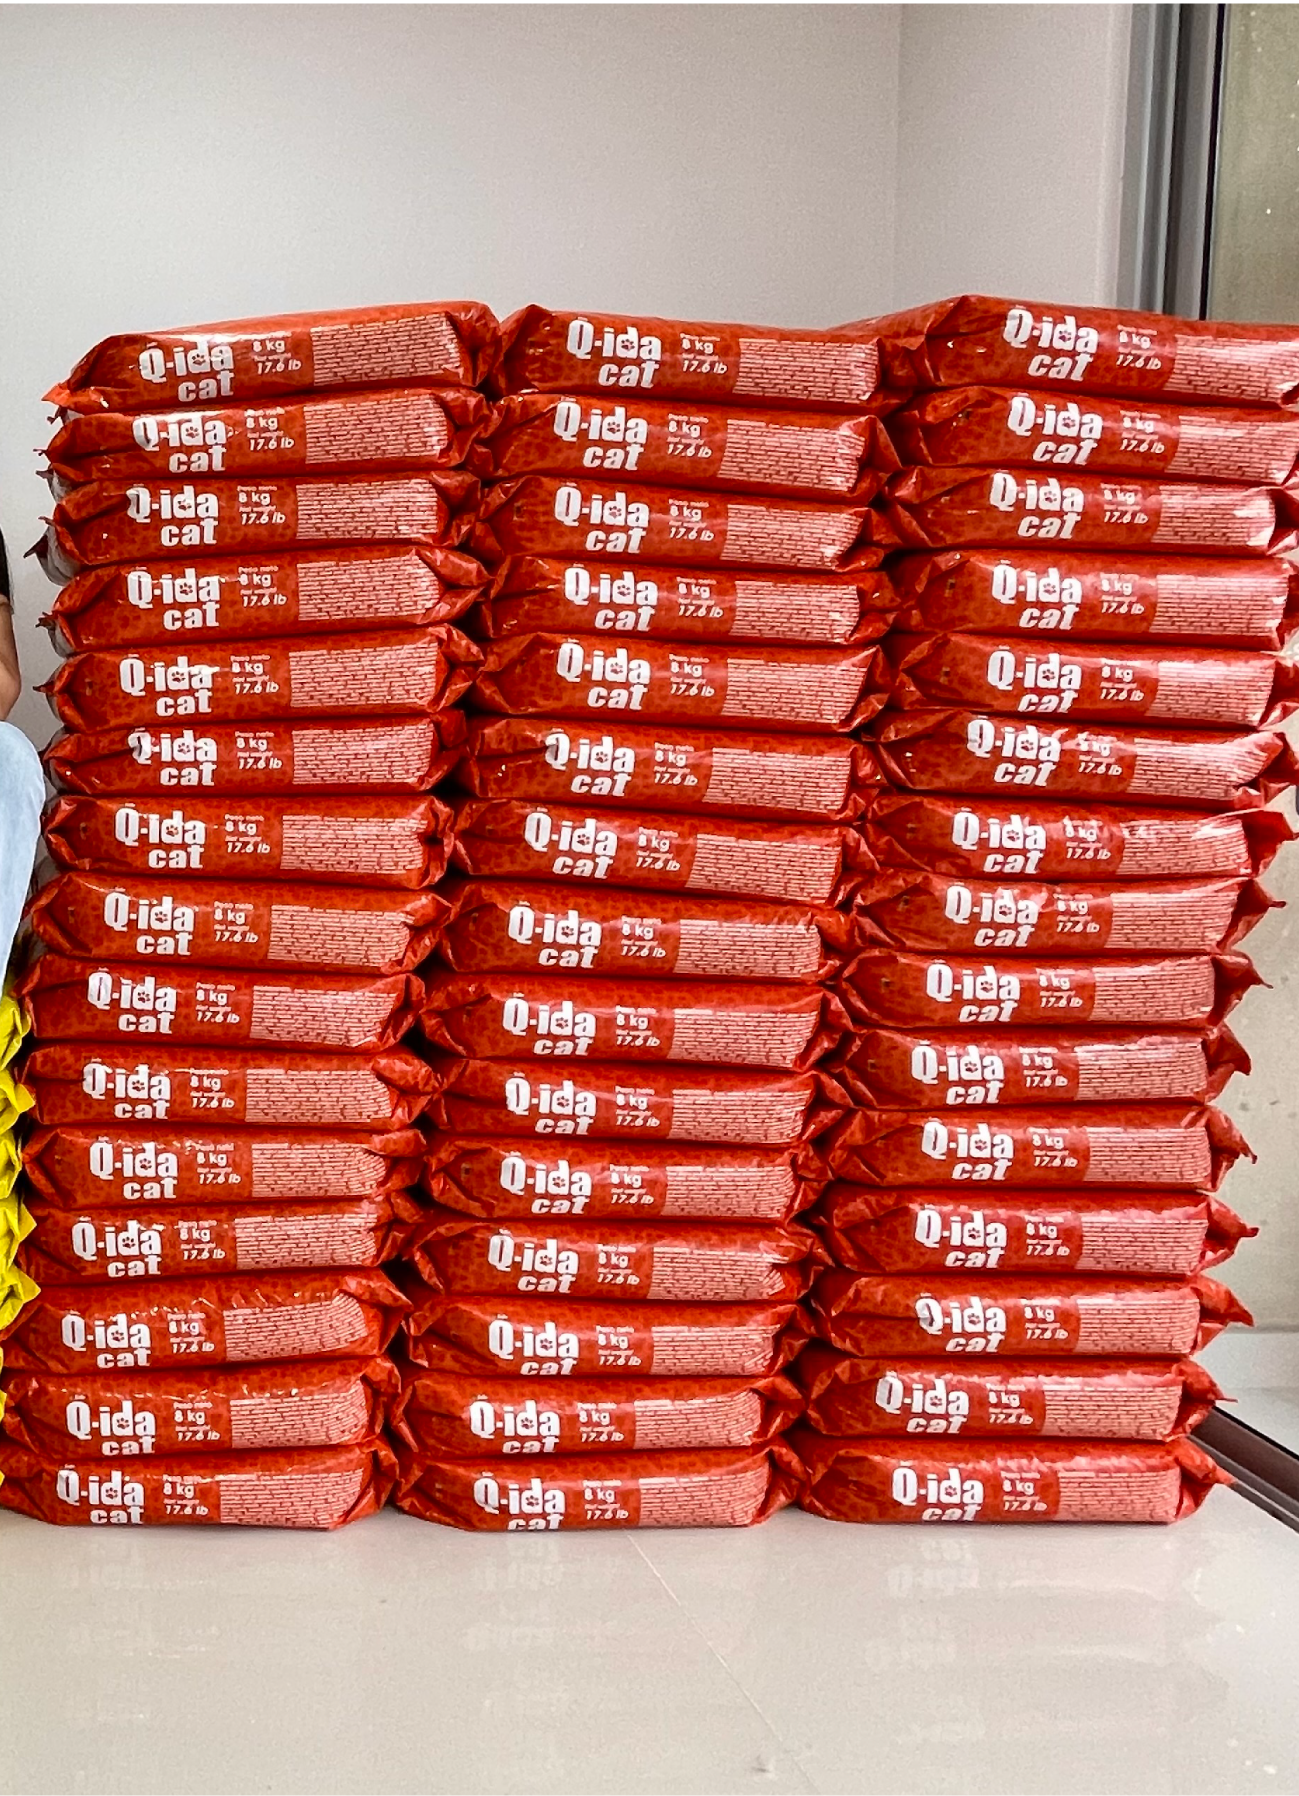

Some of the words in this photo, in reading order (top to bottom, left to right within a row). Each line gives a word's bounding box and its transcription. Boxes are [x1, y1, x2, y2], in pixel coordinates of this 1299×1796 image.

[1003, 308, 1099, 353] Q-ida
[566, 319, 662, 361] Q-ida
[682, 339, 690, 350] 8
[693, 340, 713, 354] kg
[599, 361, 659, 388] cat
[682, 360, 709, 373] 17.6
[713, 361, 727, 374] lb
[1028, 353, 1093, 380] cat
[126, 486, 219, 524] Q-ida
[239, 492, 247, 503] 8
[251, 491, 270, 506] kg
[241, 511, 270, 524] 17.6
[273, 511, 285, 523] lb
[161, 518, 218, 547] cat
[127, 568, 220, 605] Q-ida
[164, 601, 219, 630] cat
[557, 643, 650, 684] Q-ida
[671, 663, 679, 673] 8
[682, 663, 702, 677] kg
[987, 651, 1081, 690] Q-ida
[1102, 665, 1110, 676] 8
[1113, 665, 1133, 681] kg
[588, 684, 648, 710] cat
[670, 683, 698, 696] 17.6
[701, 685, 714, 697] lb
[1100, 688, 1128, 700] 17.6
[1131, 689, 1145, 701] lb
[1017, 690, 1078, 713] cat
[115, 807, 205, 845] Q-ida
[225, 821, 234, 832] 8
[236, 820, 256, 835] kg
[148, 843, 203, 868] cat
[226, 842, 255, 854] 17.6
[258, 842, 270, 853] lb
[508, 905, 601, 946] Q-ida
[622, 925, 630, 935] 8
[633, 925, 653, 939] kg
[539, 946, 598, 968] cat
[621, 945, 649, 957] 17.6
[652, 945, 666, 957] lb
[926, 964, 1020, 1002] Q-ida
[1039, 976, 1048, 987] 8
[1051, 976, 1070, 989] kg
[1040, 996, 1067, 1008] 17.6
[1070, 997, 1082, 1007] lb
[959, 1001, 1018, 1022] cat
[90, 1142, 177, 1178] Q-ida
[197, 1153, 205, 1163] 8
[208, 1152, 226, 1166] kg
[199, 1173, 226, 1184] 17.6
[229, 1173, 241, 1184] lb
[123, 1178, 177, 1199] cat
[916, 1297, 1006, 1335] Q-ida
[1024, 1307, 1033, 1318] 8
[1036, 1307, 1054, 1321] kg
[489, 1319, 579, 1359] Q-ida
[598, 1334, 606, 1346] 8
[609, 1334, 628, 1348] kg
[946, 1333, 1004, 1352] cat
[1025, 1328, 1052, 1339] 17.6
[1055, 1329, 1068, 1340] lb
[520, 1358, 577, 1375] cat
[599, 1355, 626, 1365] 17.6
[629, 1355, 641, 1365] lb
[66, 1400, 156, 1440] Q-ida
[175, 1412, 183, 1423] 8
[186, 1411, 205, 1425] kg
[177, 1430, 205, 1441] 17.6
[207, 1430, 220, 1440] lb
[102, 1437, 155, 1455] cat
